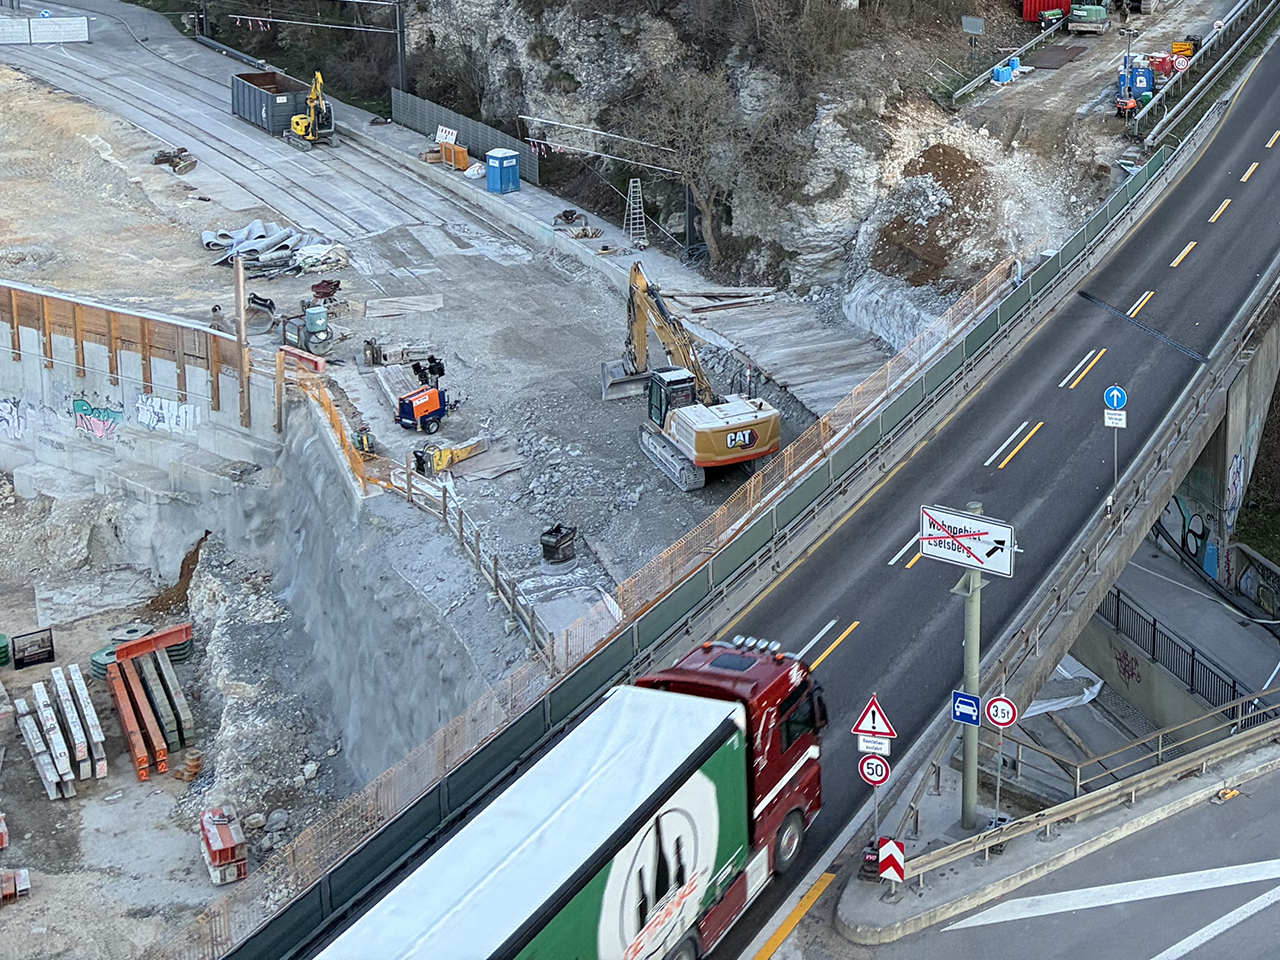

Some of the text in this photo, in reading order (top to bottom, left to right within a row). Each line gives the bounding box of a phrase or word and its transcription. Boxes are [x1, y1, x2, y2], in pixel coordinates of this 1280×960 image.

[727, 429, 751, 448] CAT
[928, 518, 981, 541] Wohngebiet
[928, 534, 971, 558] Eselsberg
[139, 770, 149, 780] 2
[866, 762, 883, 777] 50
